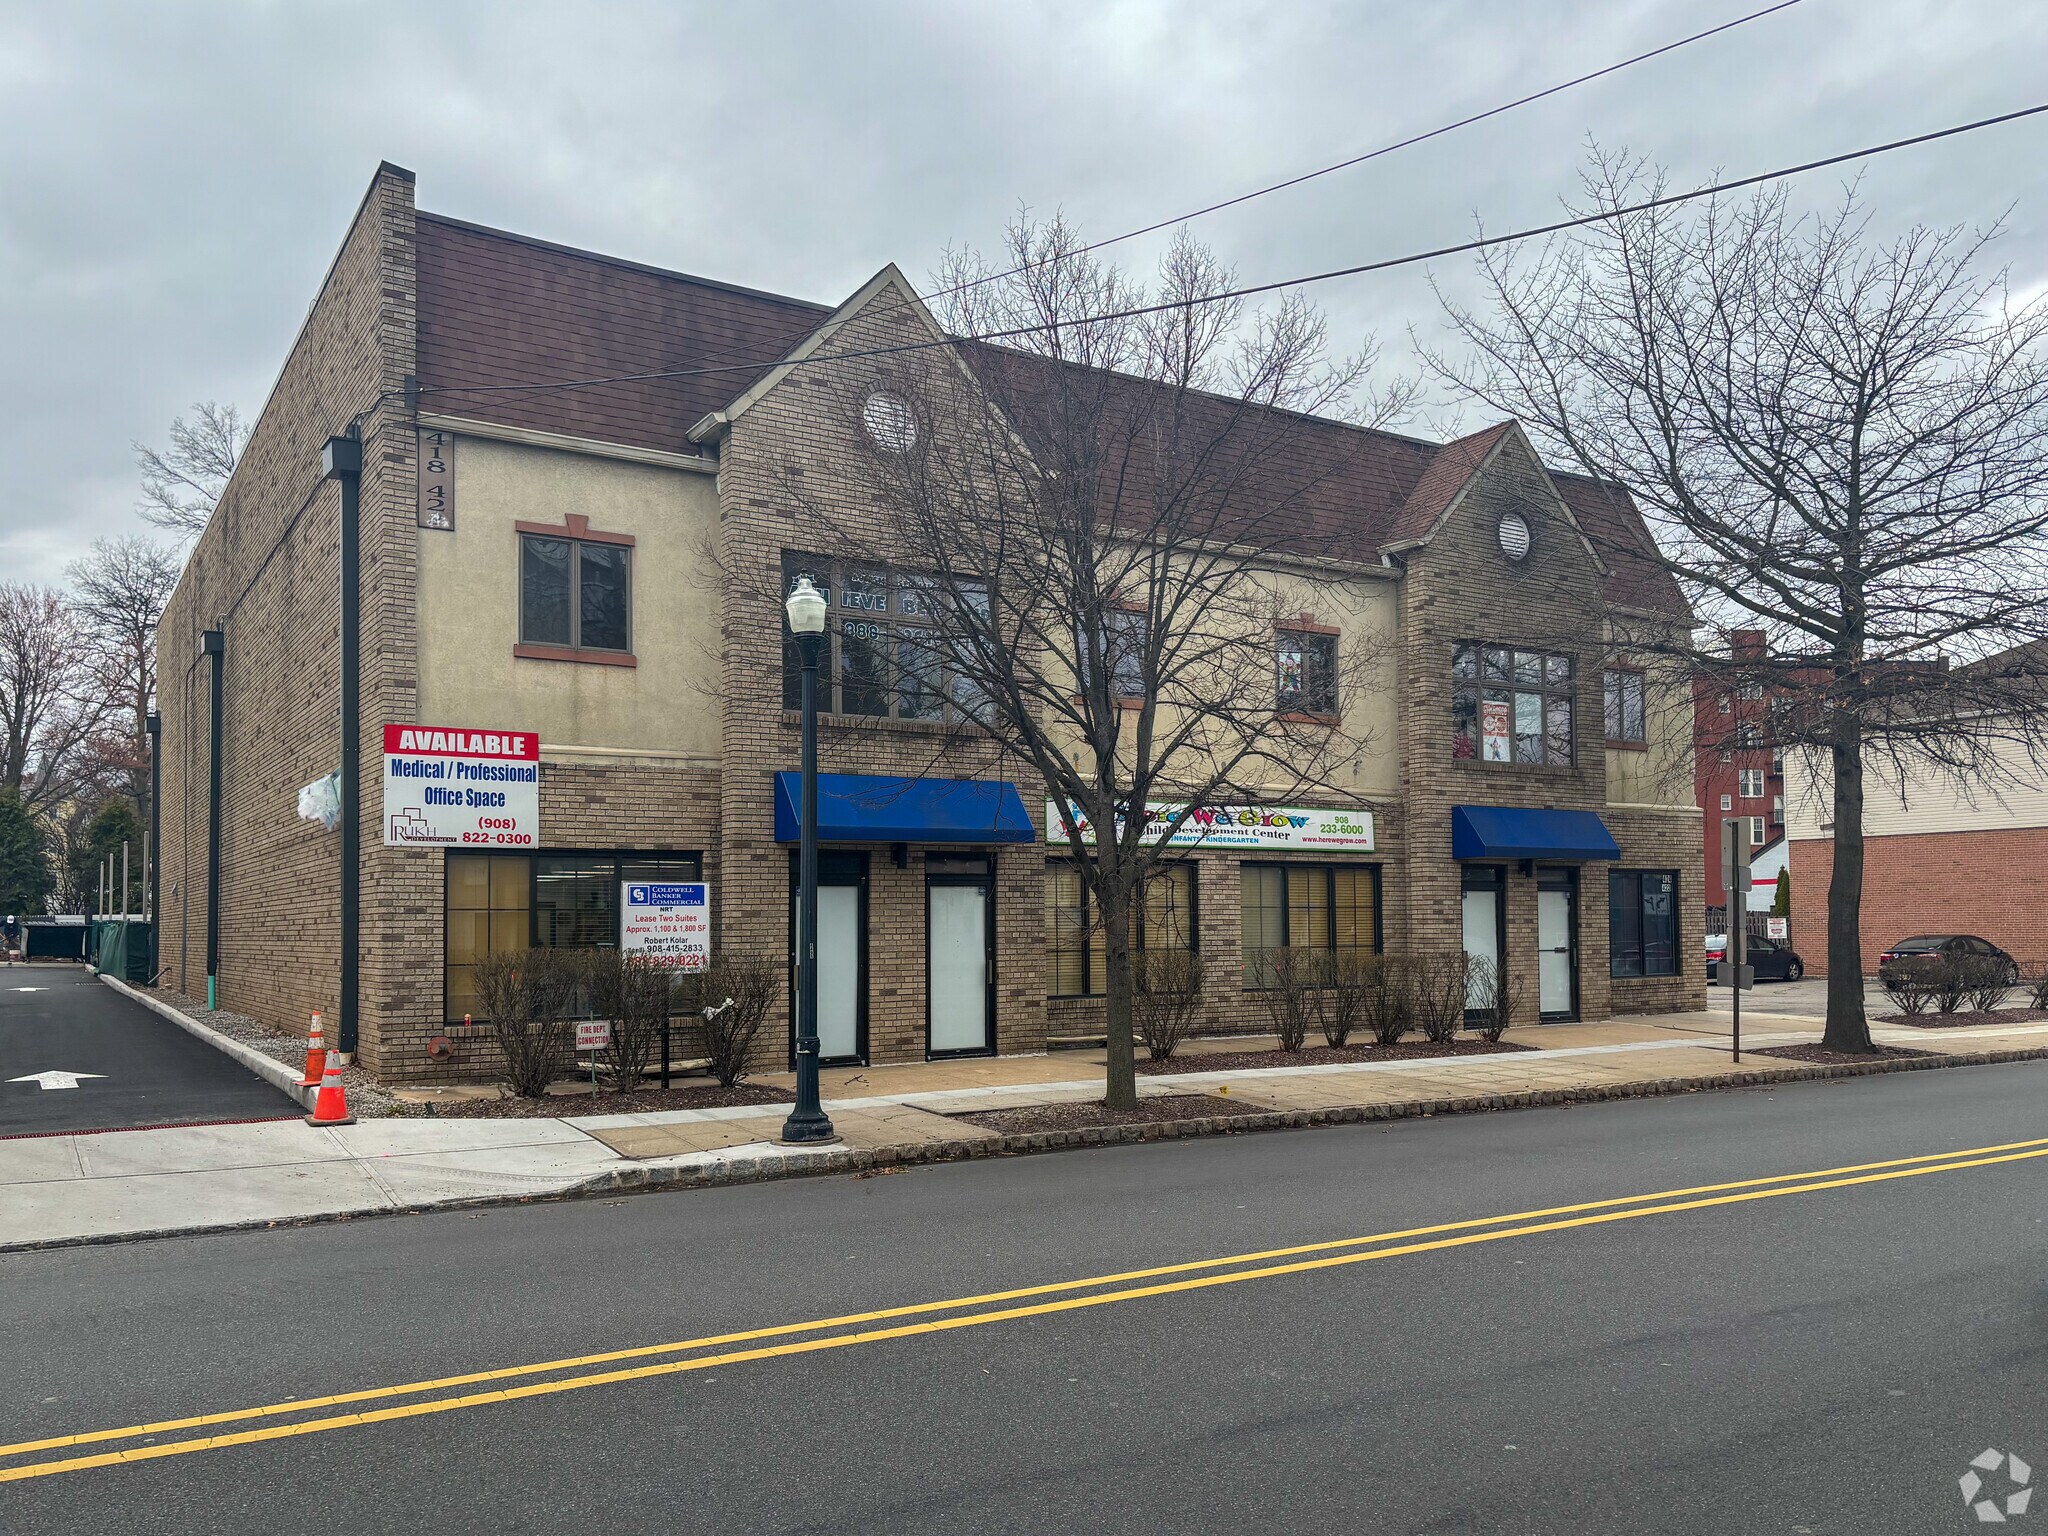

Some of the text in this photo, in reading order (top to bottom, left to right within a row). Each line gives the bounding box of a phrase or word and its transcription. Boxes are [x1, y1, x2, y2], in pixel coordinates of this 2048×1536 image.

[399, 730, 526, 756] AVAILABLE
[391, 758, 537, 783] Medical / Professional
[424, 786, 506, 808] Office Space
[478, 816, 517, 831] (908)
[1238, 809, 1310, 829] Grow
[1334, 816, 1349, 825] 908
[1140, 825, 1170, 836] hild
[1251, 828, 1291, 841] Center
[462, 832, 532, 845] 822-0300
[1205, 836, 1259, 845] KINDERGARTEN
[1301, 836, 1367, 846] www.herewegrow.com
[635, 914, 698, 923] Lease Two Suites
[625, 924, 707, 934] Approx. 1,100 & 1,800 SF
[644, 937, 669, 945] Robert
[646, 944, 703, 953] 908-415-2833
[580, 1025, 592, 1034] FIRE
[577, 1036, 609, 1045] CONNECTION
